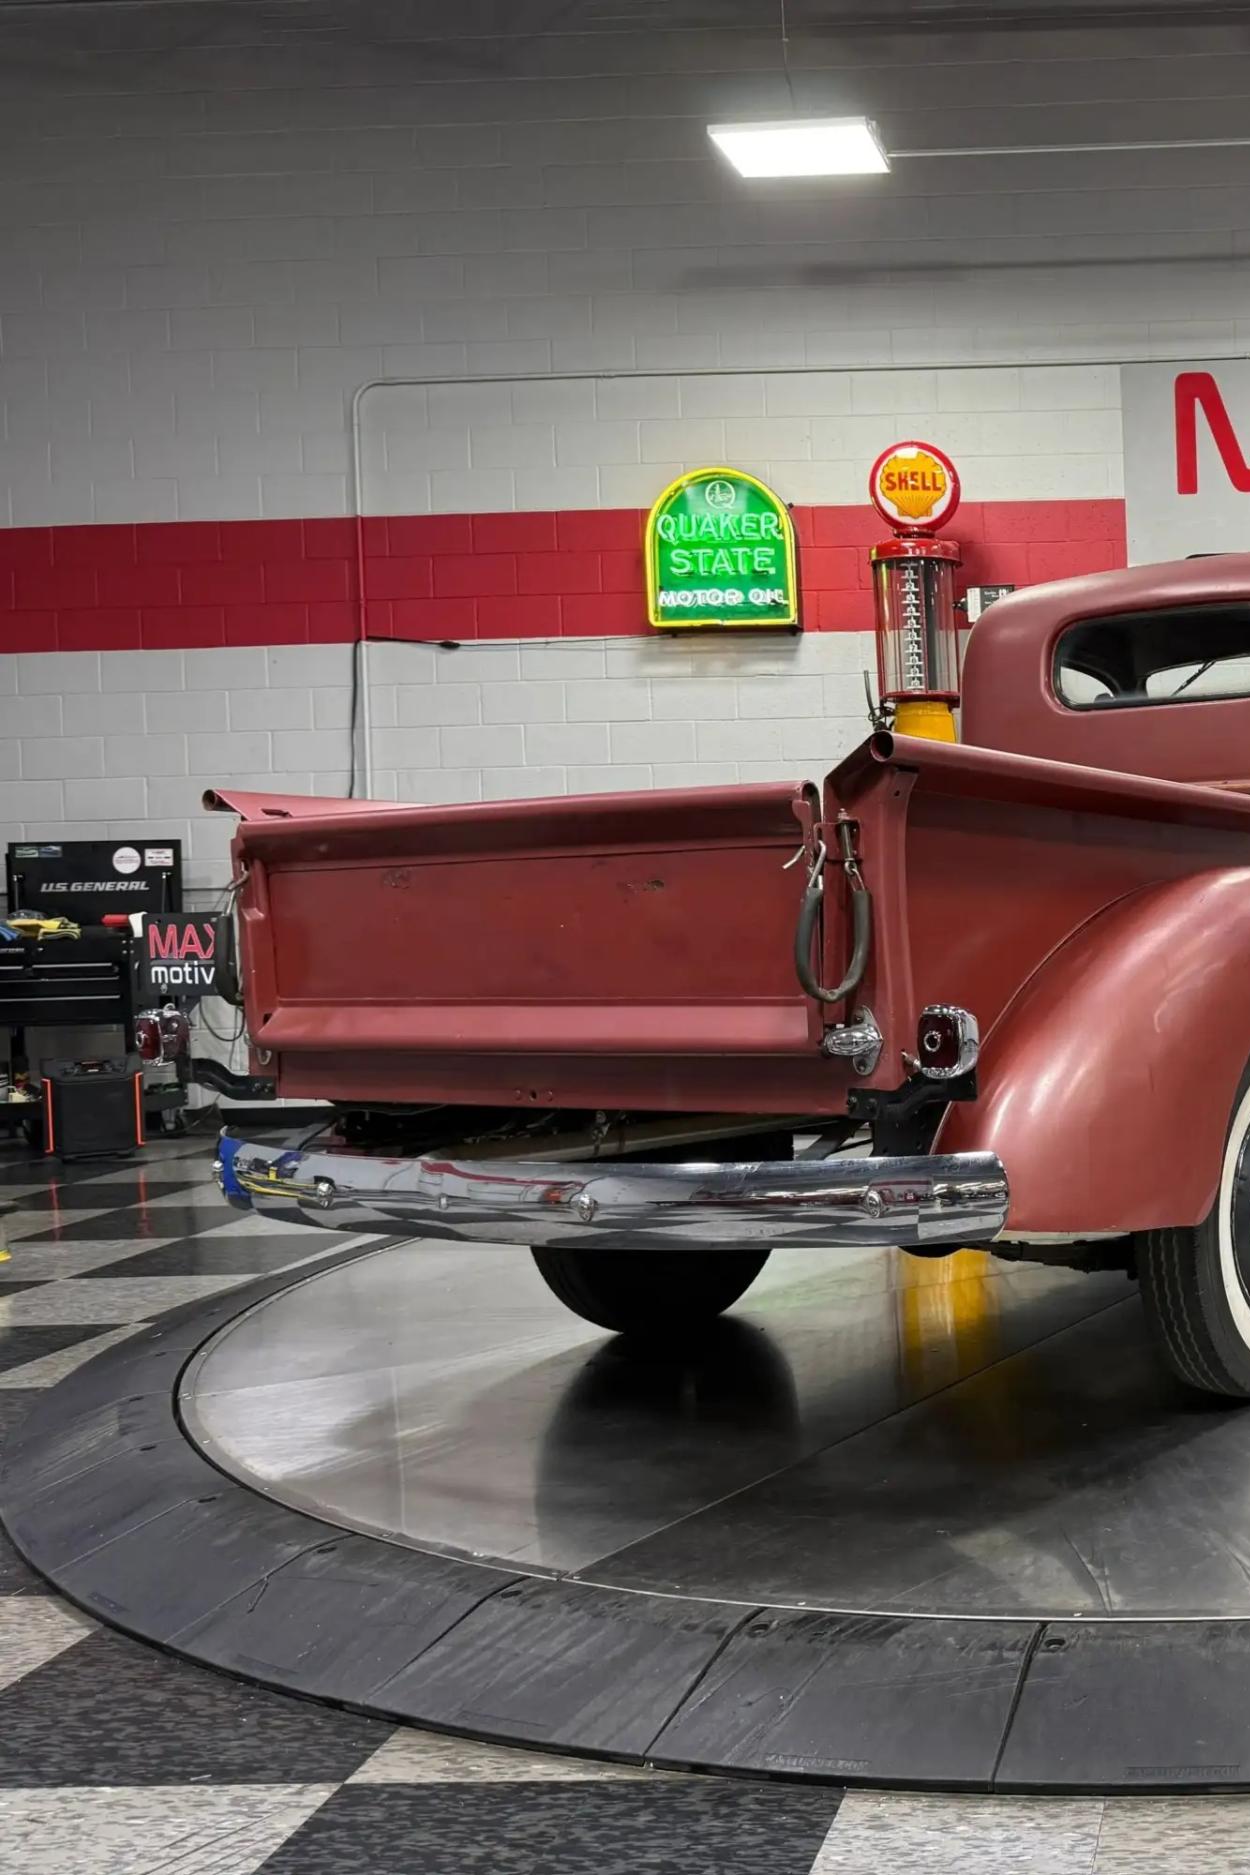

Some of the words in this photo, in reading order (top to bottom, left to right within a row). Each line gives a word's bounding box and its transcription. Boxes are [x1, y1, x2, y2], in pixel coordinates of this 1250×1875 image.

[885, 471, 942, 491] SHELL
[656, 511, 784, 546] QUAKER
[669, 547, 776, 576] STATE
[659, 588, 745, 607] MOTOR
[748, 588, 789, 606] OIL
[70, 880, 150, 893] GENERAL
